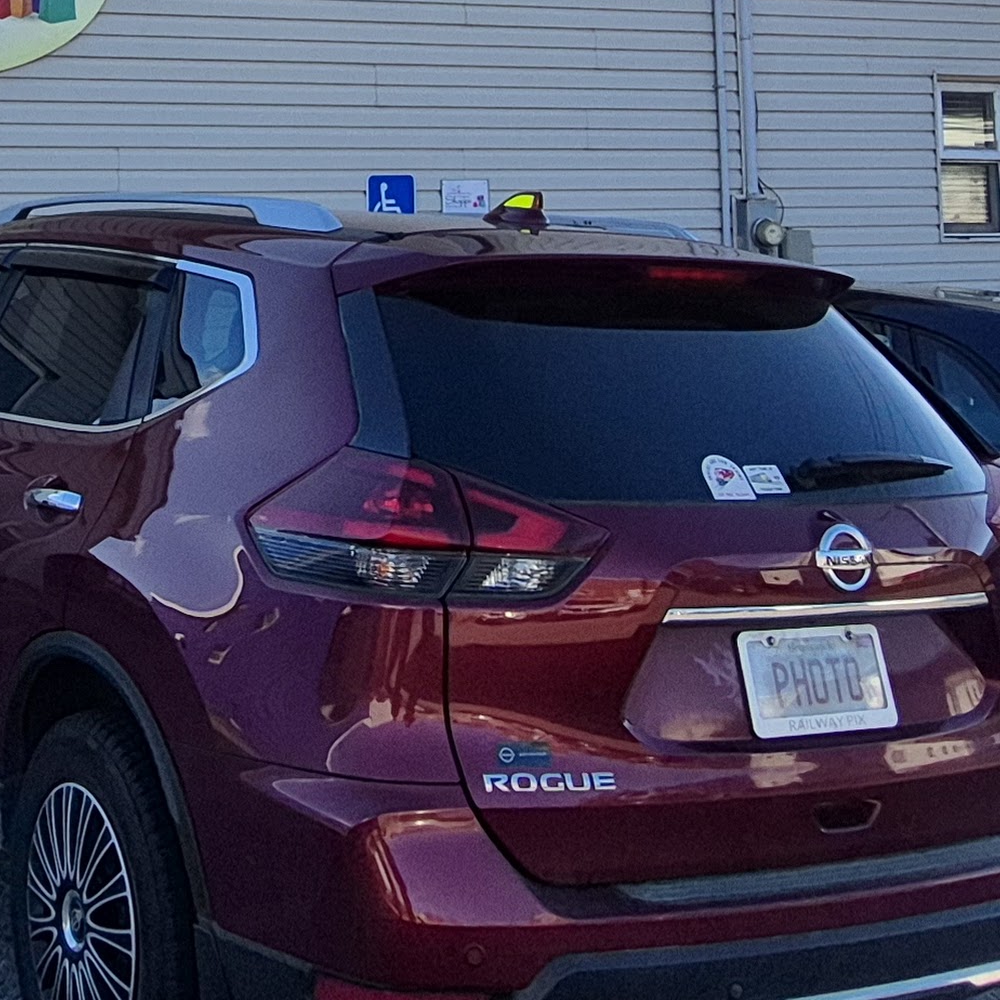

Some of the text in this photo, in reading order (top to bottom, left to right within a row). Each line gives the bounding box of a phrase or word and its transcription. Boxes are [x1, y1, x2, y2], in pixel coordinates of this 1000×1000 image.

[771, 656, 864, 708] PHOTO
[788, 714, 867, 732] RAILWAY PIX
[483, 772, 617, 792] ROGUE
